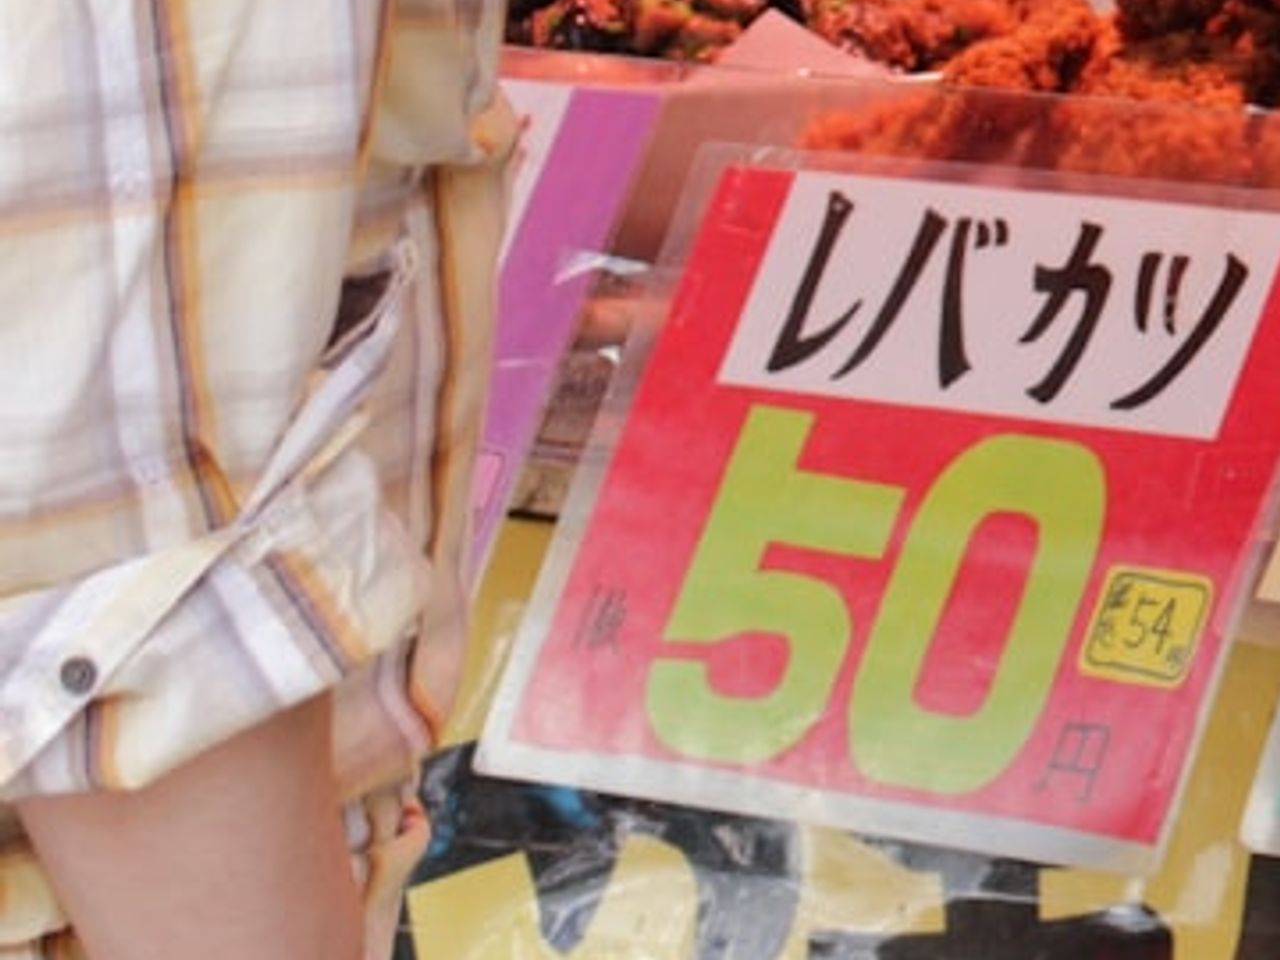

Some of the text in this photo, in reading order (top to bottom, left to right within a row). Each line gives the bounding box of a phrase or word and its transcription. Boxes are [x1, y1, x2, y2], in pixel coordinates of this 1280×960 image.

[765, 189, 1250, 411] レバカツ
[645, 403, 1108, 796] 50
[1035, 722, 1113, 807] 円
